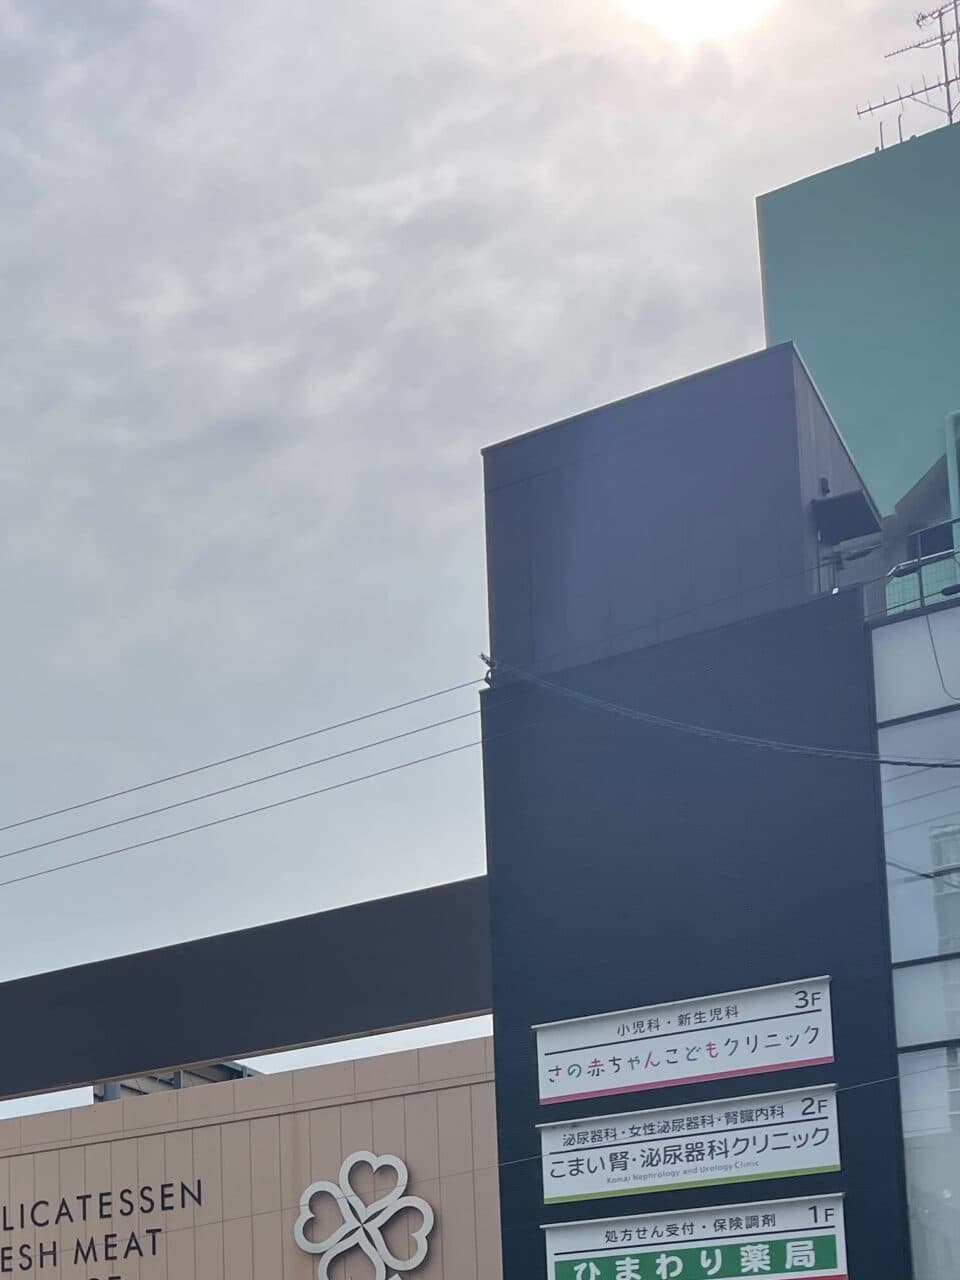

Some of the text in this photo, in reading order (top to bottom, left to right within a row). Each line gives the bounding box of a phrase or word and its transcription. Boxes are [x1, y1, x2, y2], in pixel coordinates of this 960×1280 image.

[794, 990, 822, 1009] 3F
[617, 1005, 739, 1037] 小児科・新生児科
[548, 1025, 820, 1083] さの赤ちゃんこどもクリニック
[800, 1097, 828, 1117] 2F
[562, 1103, 785, 1147] 泌尿器科・女性泌尿器科・腎臓内科
[549, 1126, 830, 1179] こまい腎・泌尿器科クリニック
[632, 1168, 680, 1182] Nephrology
[683, 1166, 698, 1175] and
[699, 1163, 733, 1175] Urology
[734, 1159, 760, 1169] Clinic
[605, 1213, 776, 1243] 処方せん受付・保険調剤
[809, 1205, 835, 1223] 1F
[73, 1228, 162, 1266] MEAT
